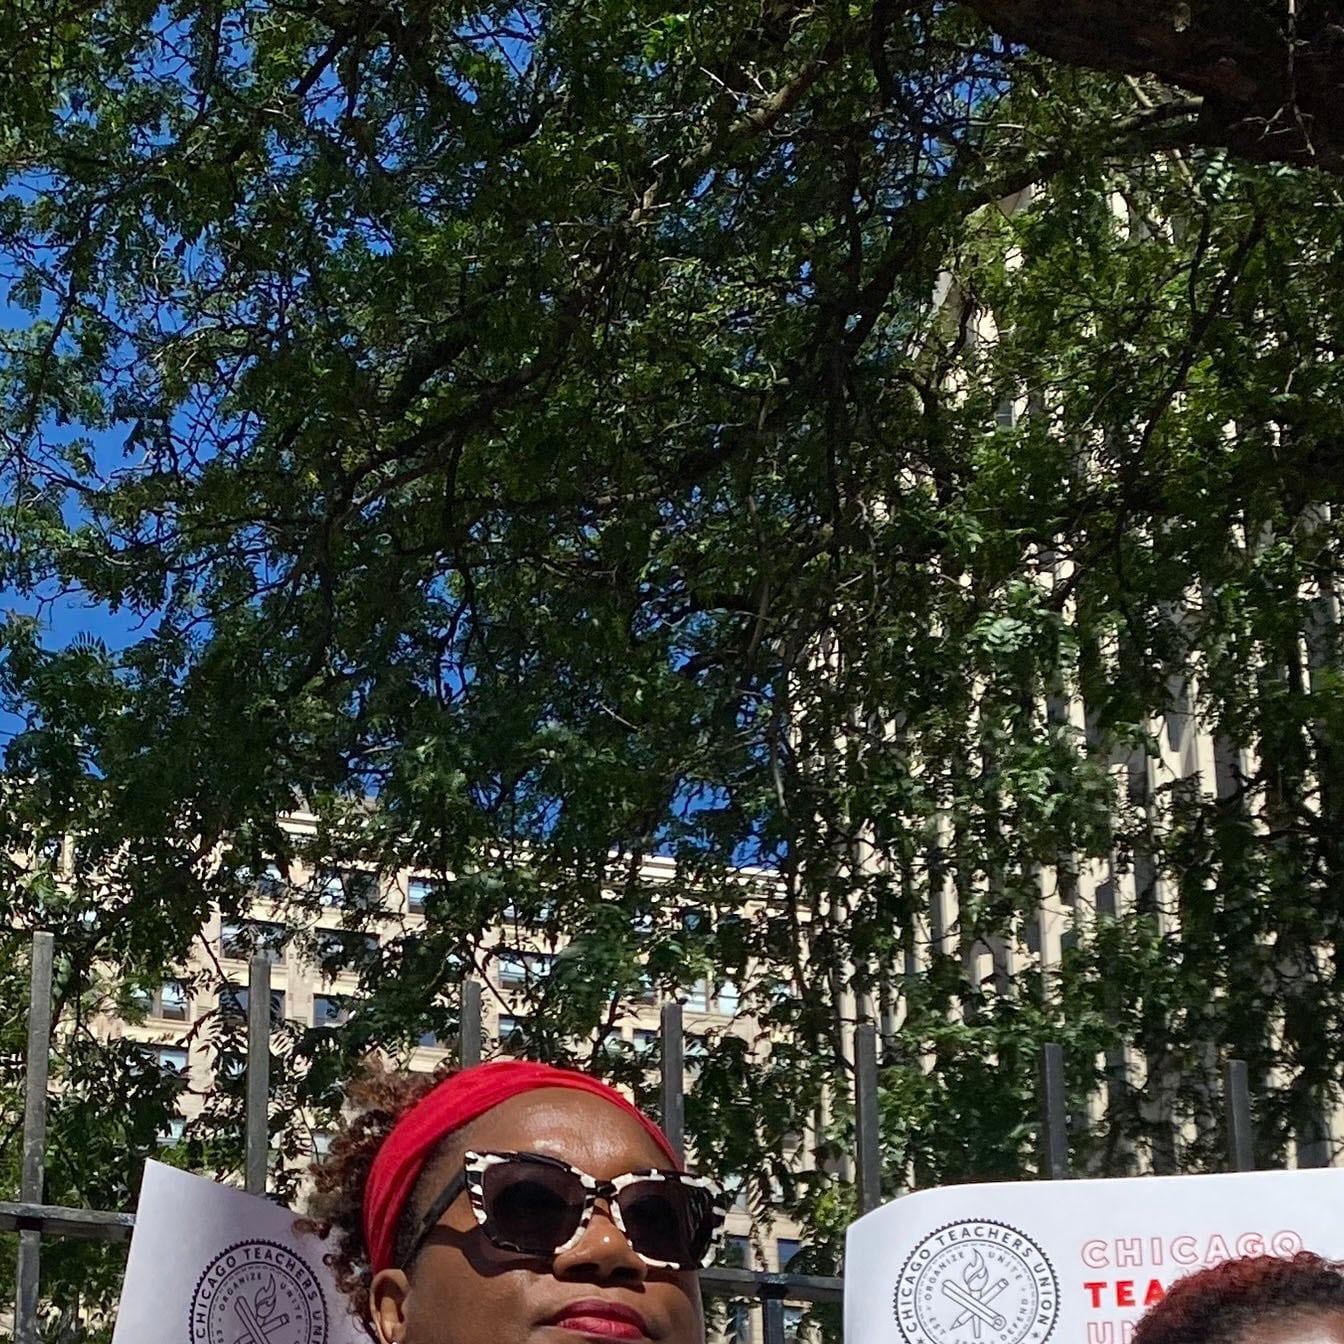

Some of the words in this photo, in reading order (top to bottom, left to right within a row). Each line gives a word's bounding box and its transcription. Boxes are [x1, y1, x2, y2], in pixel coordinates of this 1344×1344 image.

[195, 1256, 236, 1338] CHICAGO
[245, 1248, 317, 1301] TEACHERS
[901, 1249, 930, 1332] CHICAGO
[936, 1226, 1033, 1259] TEACHERS
[1033, 1263, 1052, 1325] UNION
[1081, 1230, 1303, 1270] CHICAGO
